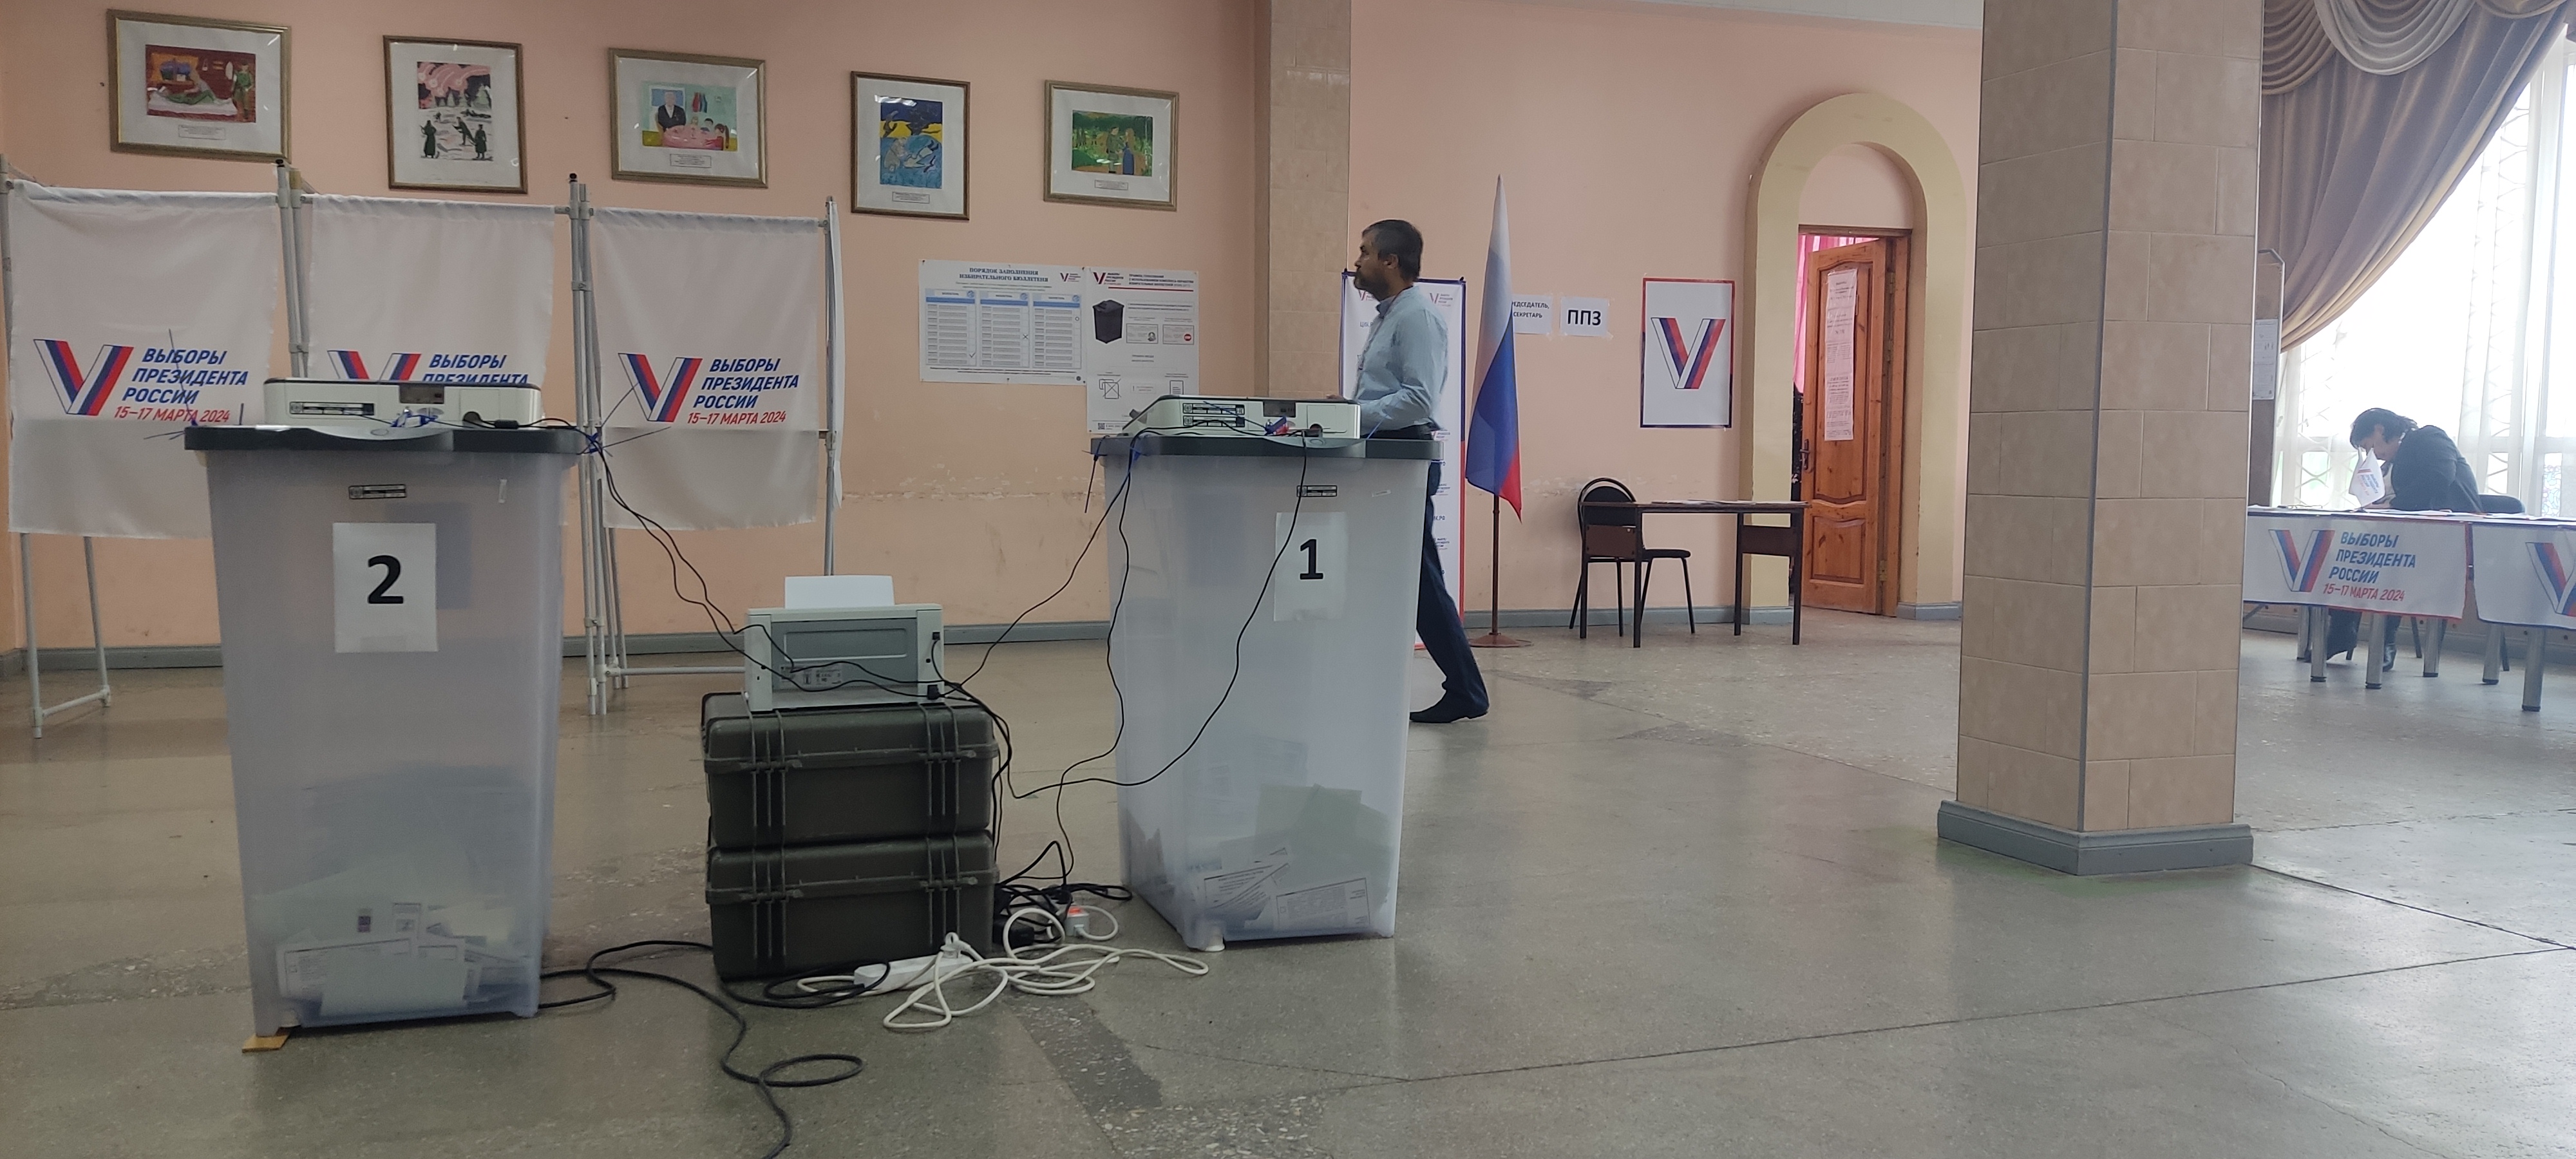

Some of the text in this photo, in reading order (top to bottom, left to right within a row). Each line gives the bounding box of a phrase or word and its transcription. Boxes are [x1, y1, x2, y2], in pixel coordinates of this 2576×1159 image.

[142, 348, 227, 364] ВЫБОРЫ
[429, 354, 507, 368] ВЫБОРЫ
[709, 358, 781, 372] ВЫБОРЫ
[132, 368, 249, 386] ПРЕЗИДЕНТА
[701, 375, 799, 391] ПРЕЗИДЕНТА
[122, 388, 199, 404] РОССИИ
[693, 395, 759, 408] РОССИИ
[154, 408, 198, 422] МАРТА
[200, 410, 231, 422] 2024
[719, 413, 758, 425] МАРТА
[760, 411, 786, 424] 2024
[2340, 532, 2399, 547] ВЫБОРЫ
[1299, 538, 1324, 580] 1
[2336, 549, 2416, 568] ПРЕЗИДЕНТА
[366, 555, 404, 605] 2
[2329, 567, 2379, 583] РОССИИ
[2350, 587, 2378, 599] МАРТА
[2380, 590, 2405, 601] 2024
